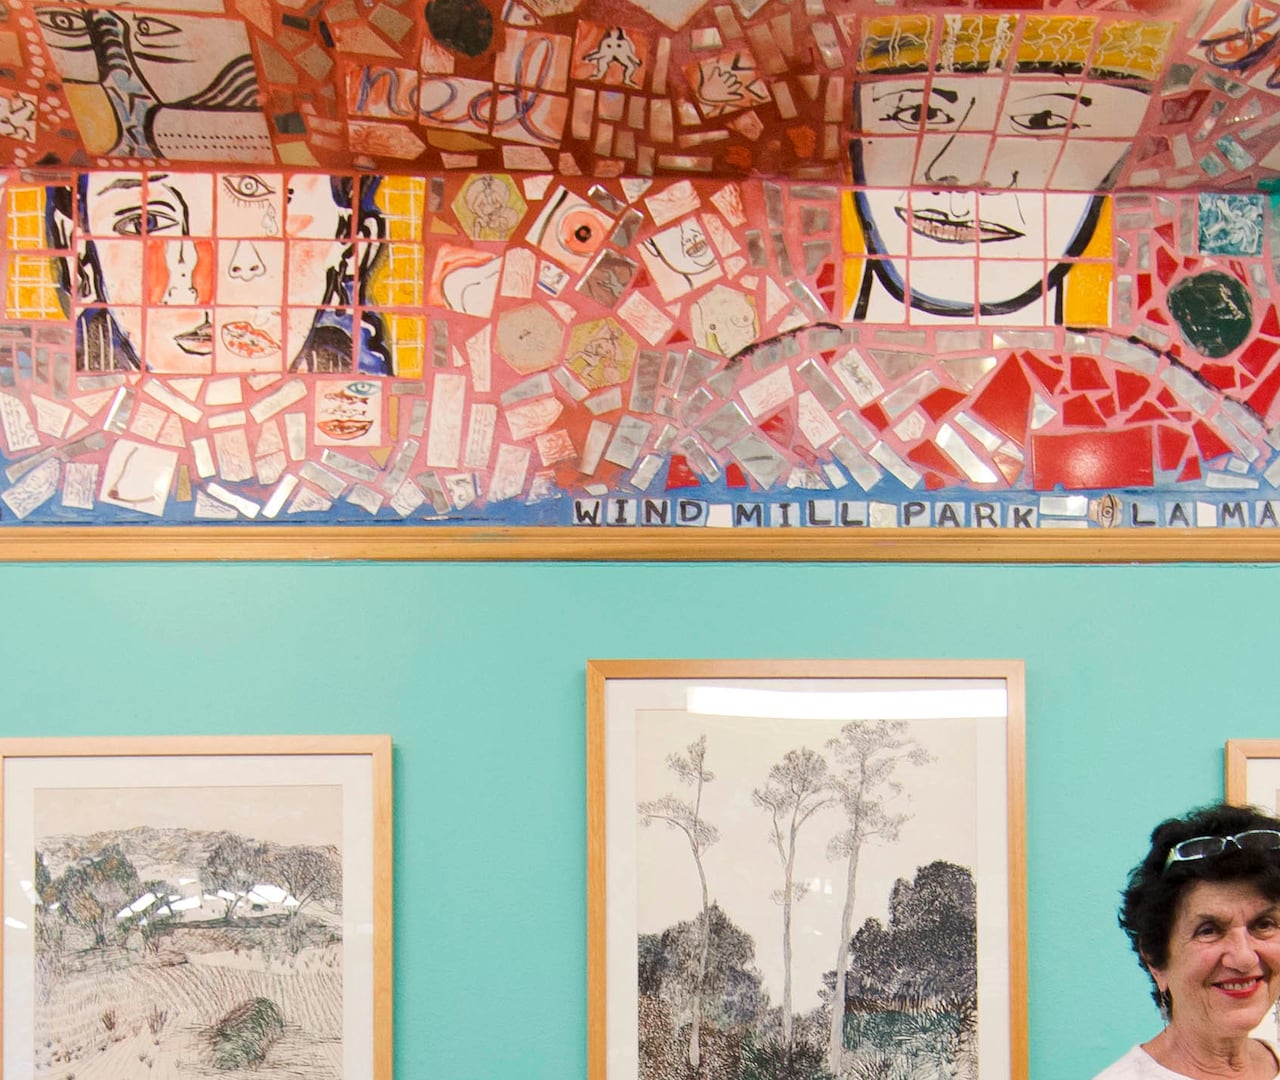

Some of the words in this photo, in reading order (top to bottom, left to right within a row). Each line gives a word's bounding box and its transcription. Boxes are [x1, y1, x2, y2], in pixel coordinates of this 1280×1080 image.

[575, 500, 704, 526] WIND
[736, 503, 867, 527] MILL
[904, 502, 1034, 528] PARK
[1133, 501, 1190, 528] LA
